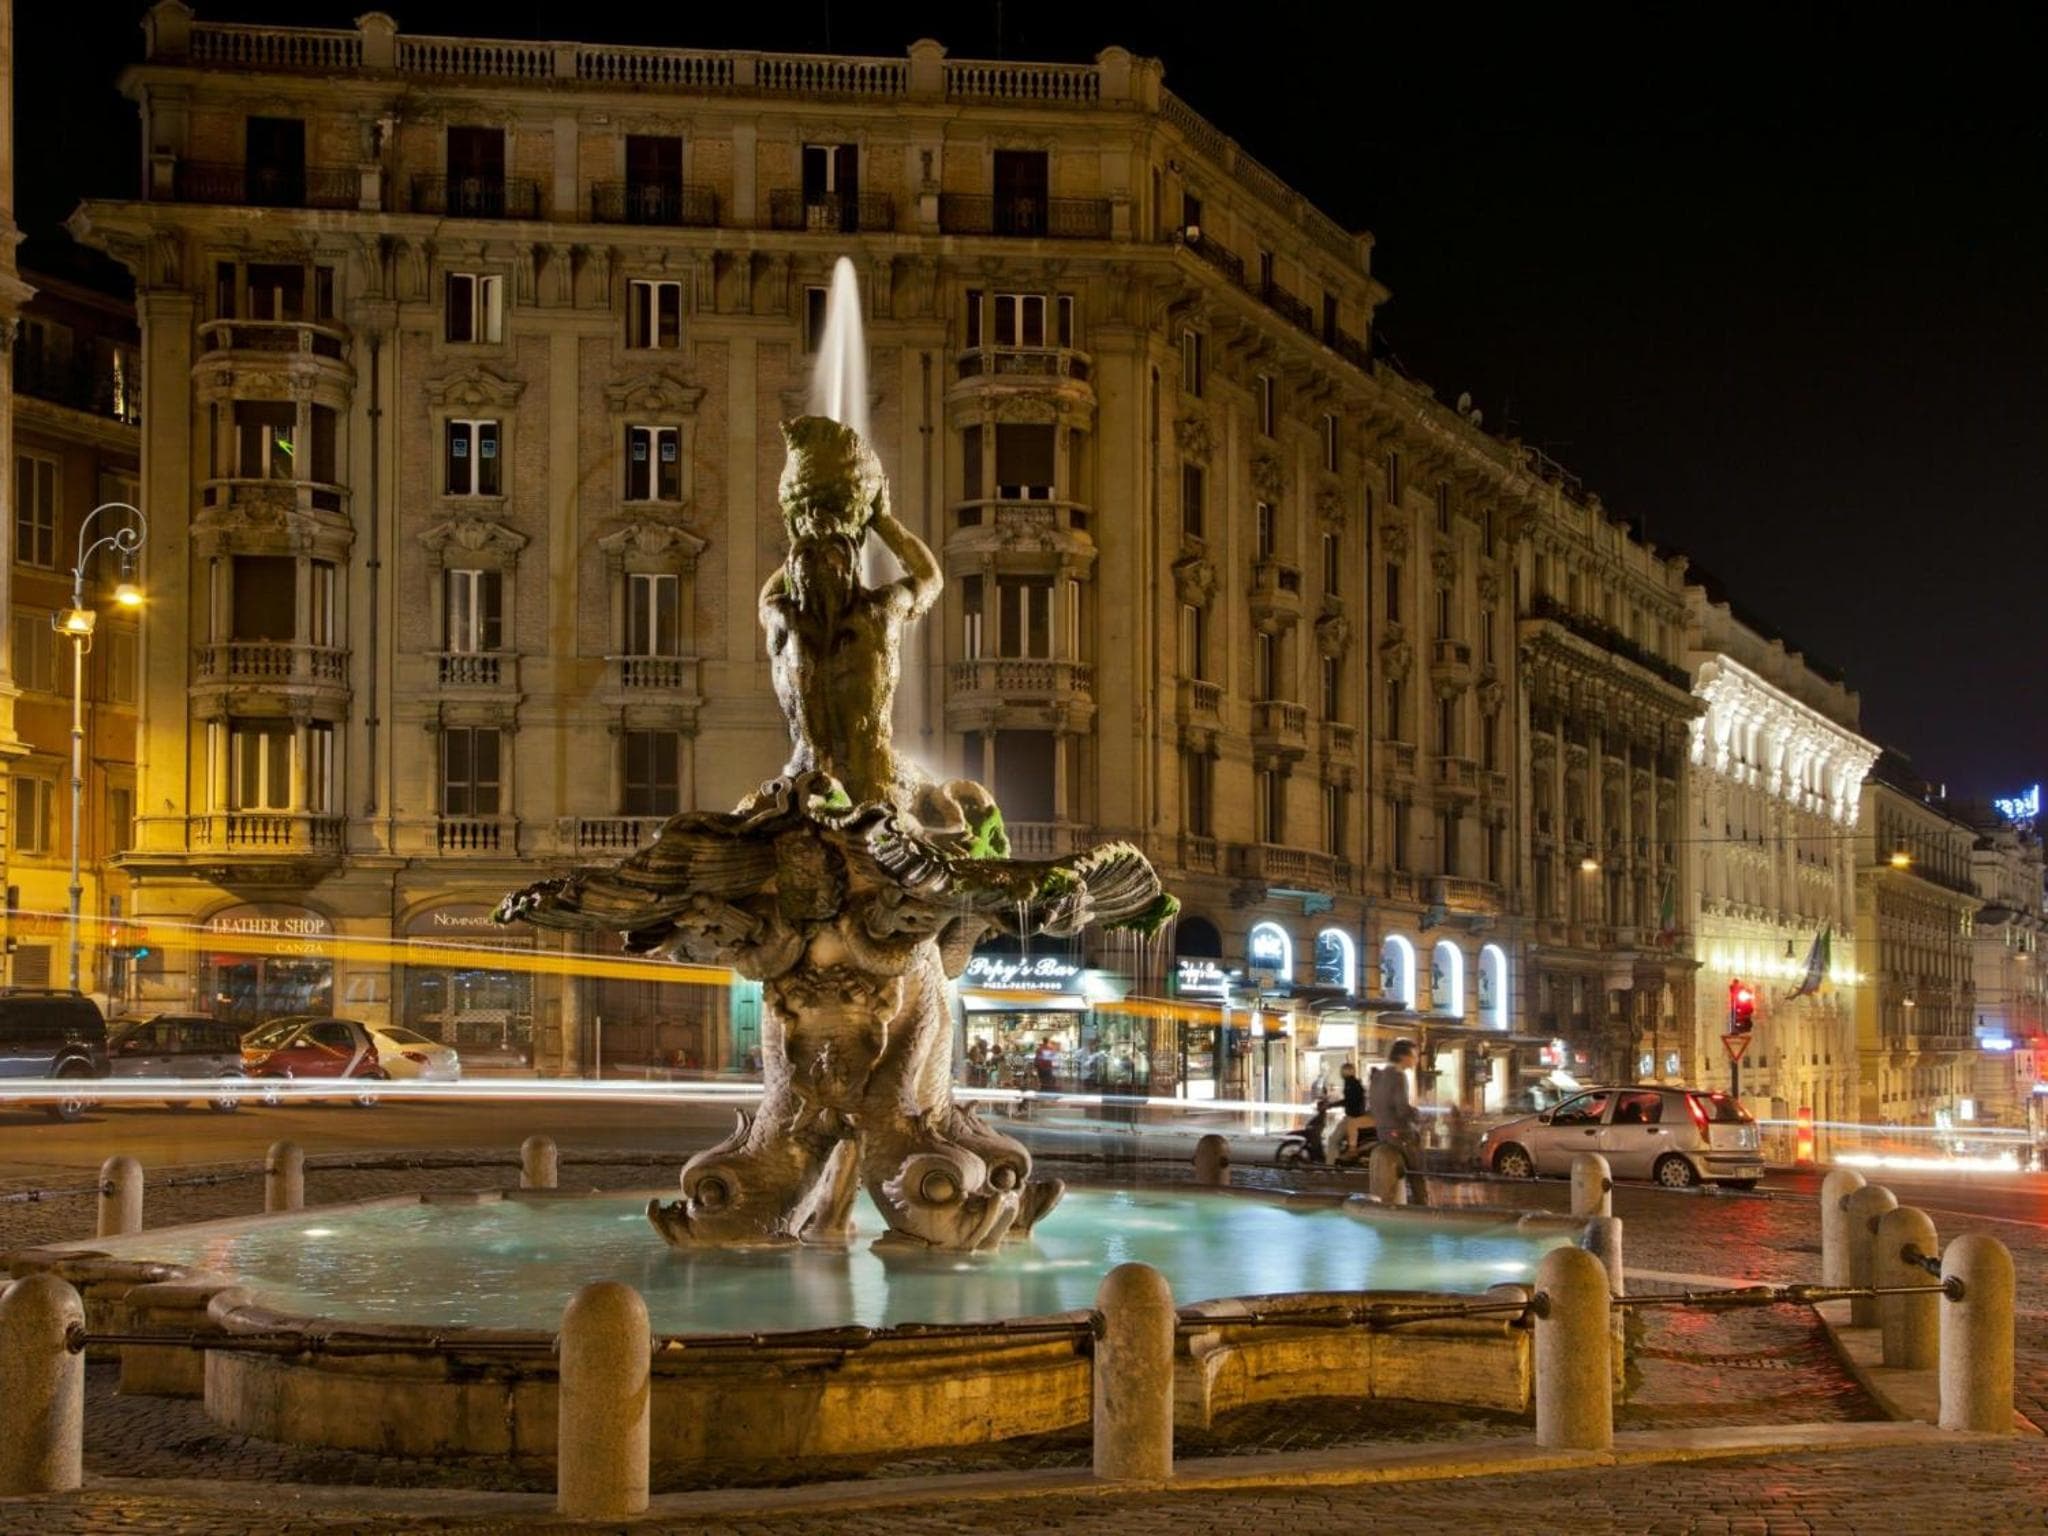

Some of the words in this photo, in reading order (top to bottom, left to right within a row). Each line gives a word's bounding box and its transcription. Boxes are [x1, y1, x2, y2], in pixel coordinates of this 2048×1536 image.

[213, 918, 279, 934] LEATHER
[284, 918, 324, 934] SHOP
[1034, 958, 1079, 976] Bar
